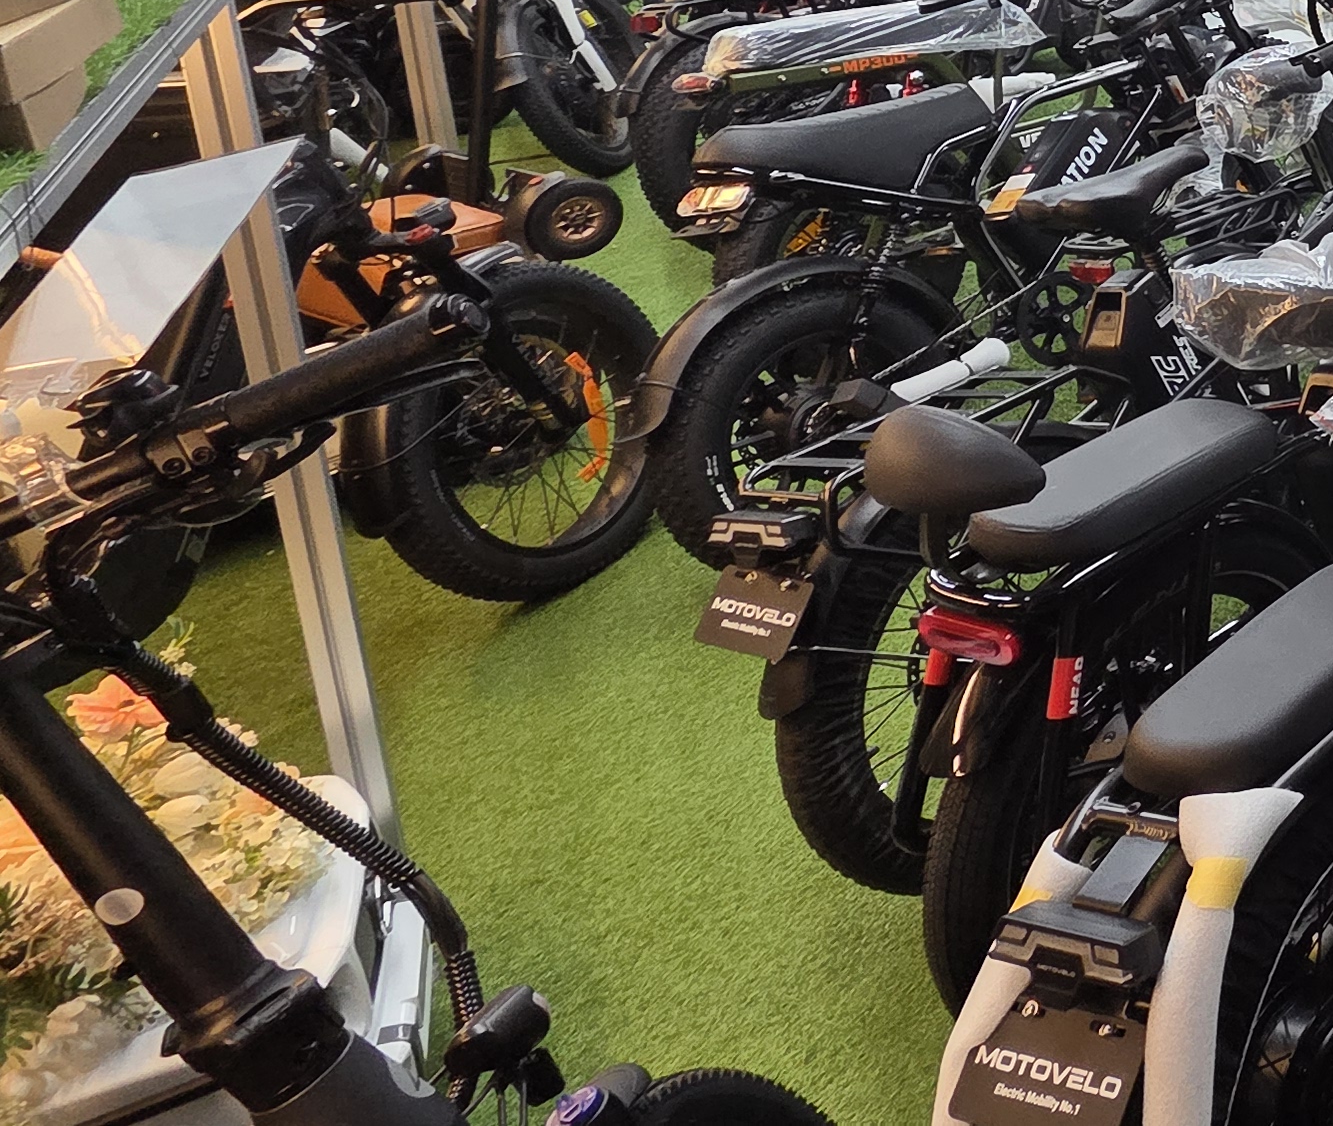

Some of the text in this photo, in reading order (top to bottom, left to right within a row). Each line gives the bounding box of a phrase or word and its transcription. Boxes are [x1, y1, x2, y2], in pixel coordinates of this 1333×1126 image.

[711, 596, 797, 628] MOTOVELO
[1036, 962, 1077, 978] MOTOVELO
[974, 1044, 1123, 1100] MOTOVELO
[993, 1082, 1082, 1116] Electric Mobility No.1
